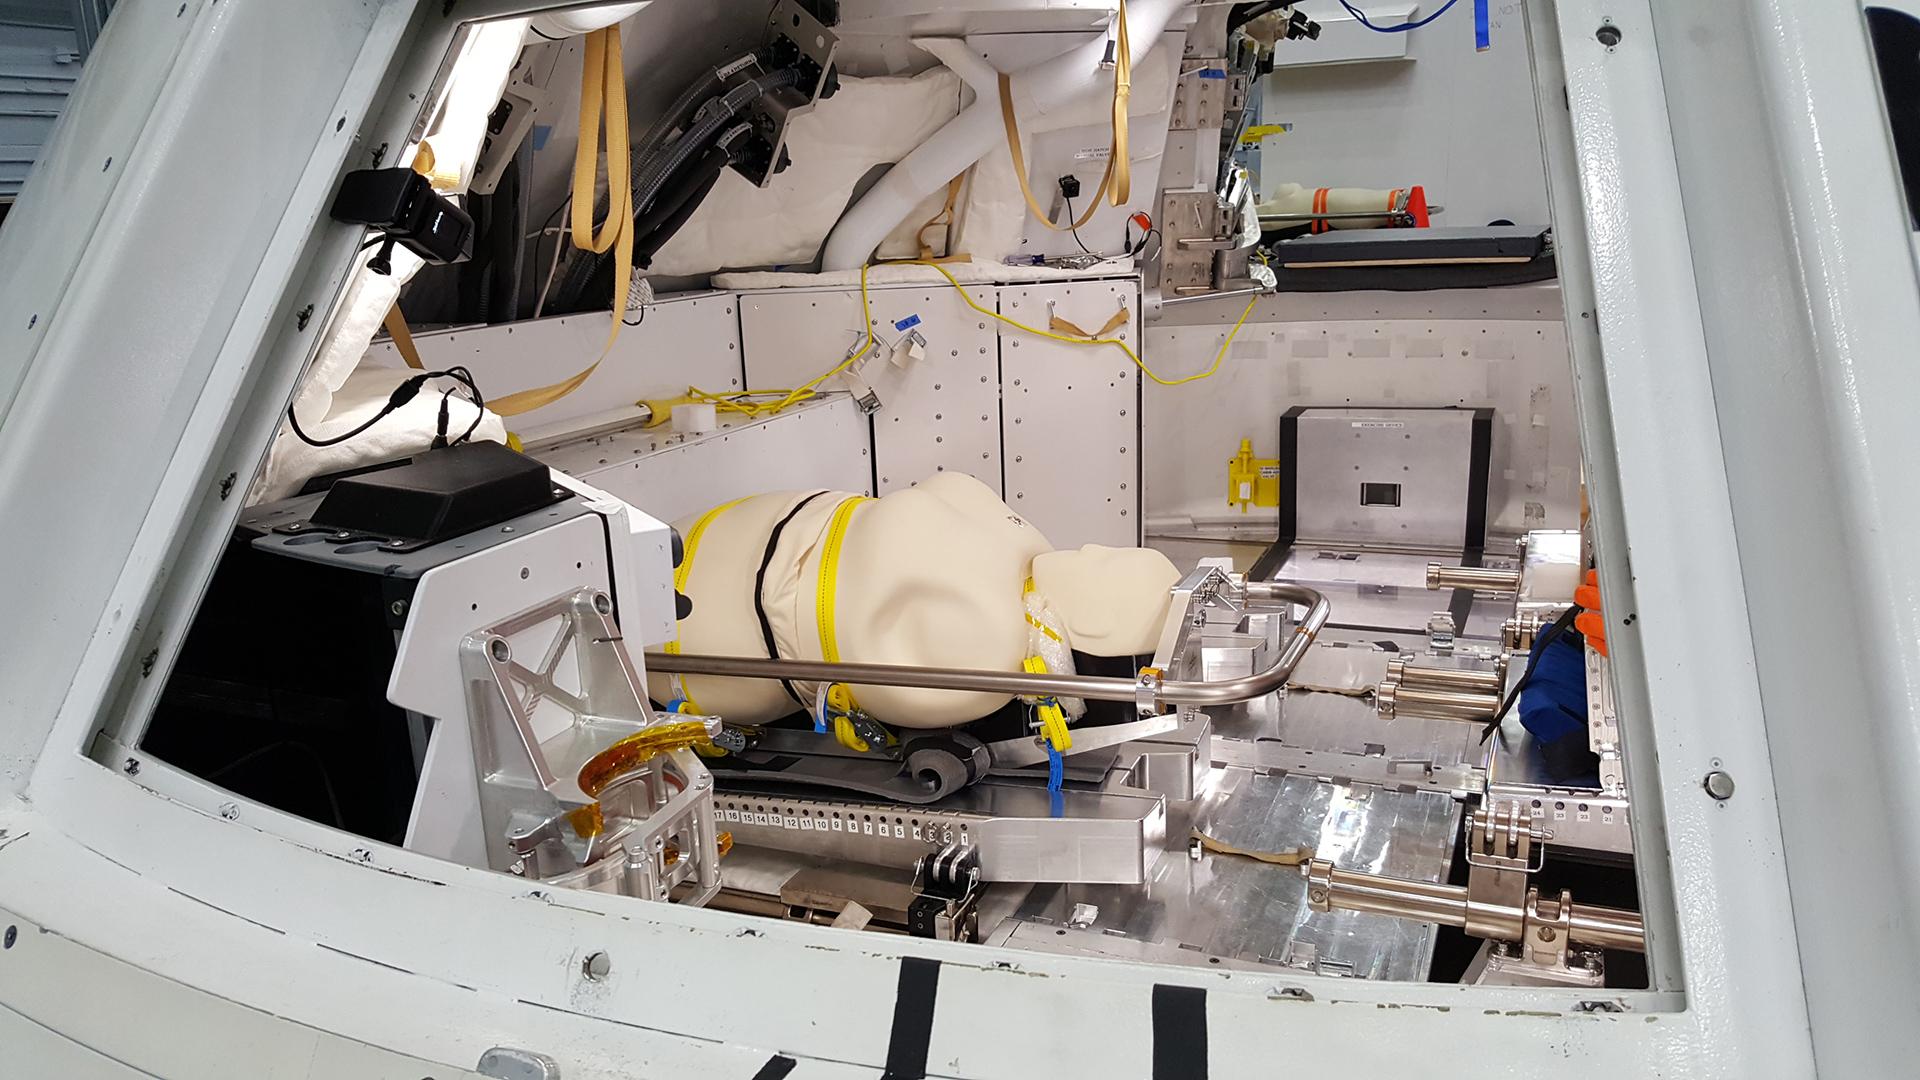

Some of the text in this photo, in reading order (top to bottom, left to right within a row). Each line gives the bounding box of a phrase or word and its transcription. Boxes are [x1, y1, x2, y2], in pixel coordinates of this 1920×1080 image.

[713, 811, 721, 819] 17
[743, 814, 752, 822] 15
[757, 815, 765, 823] 14
[771, 816, 780, 824] 13
[787, 819, 796, 827] 12
[818, 821, 826, 829] 10
[866, 824, 871, 832] 7
[881, 826, 886, 834] 6
[896, 828, 903, 836] 5
[930, 831, 935, 839] 3
[945, 833, 952, 841] 2
[962, 835, 967, 843] 1
